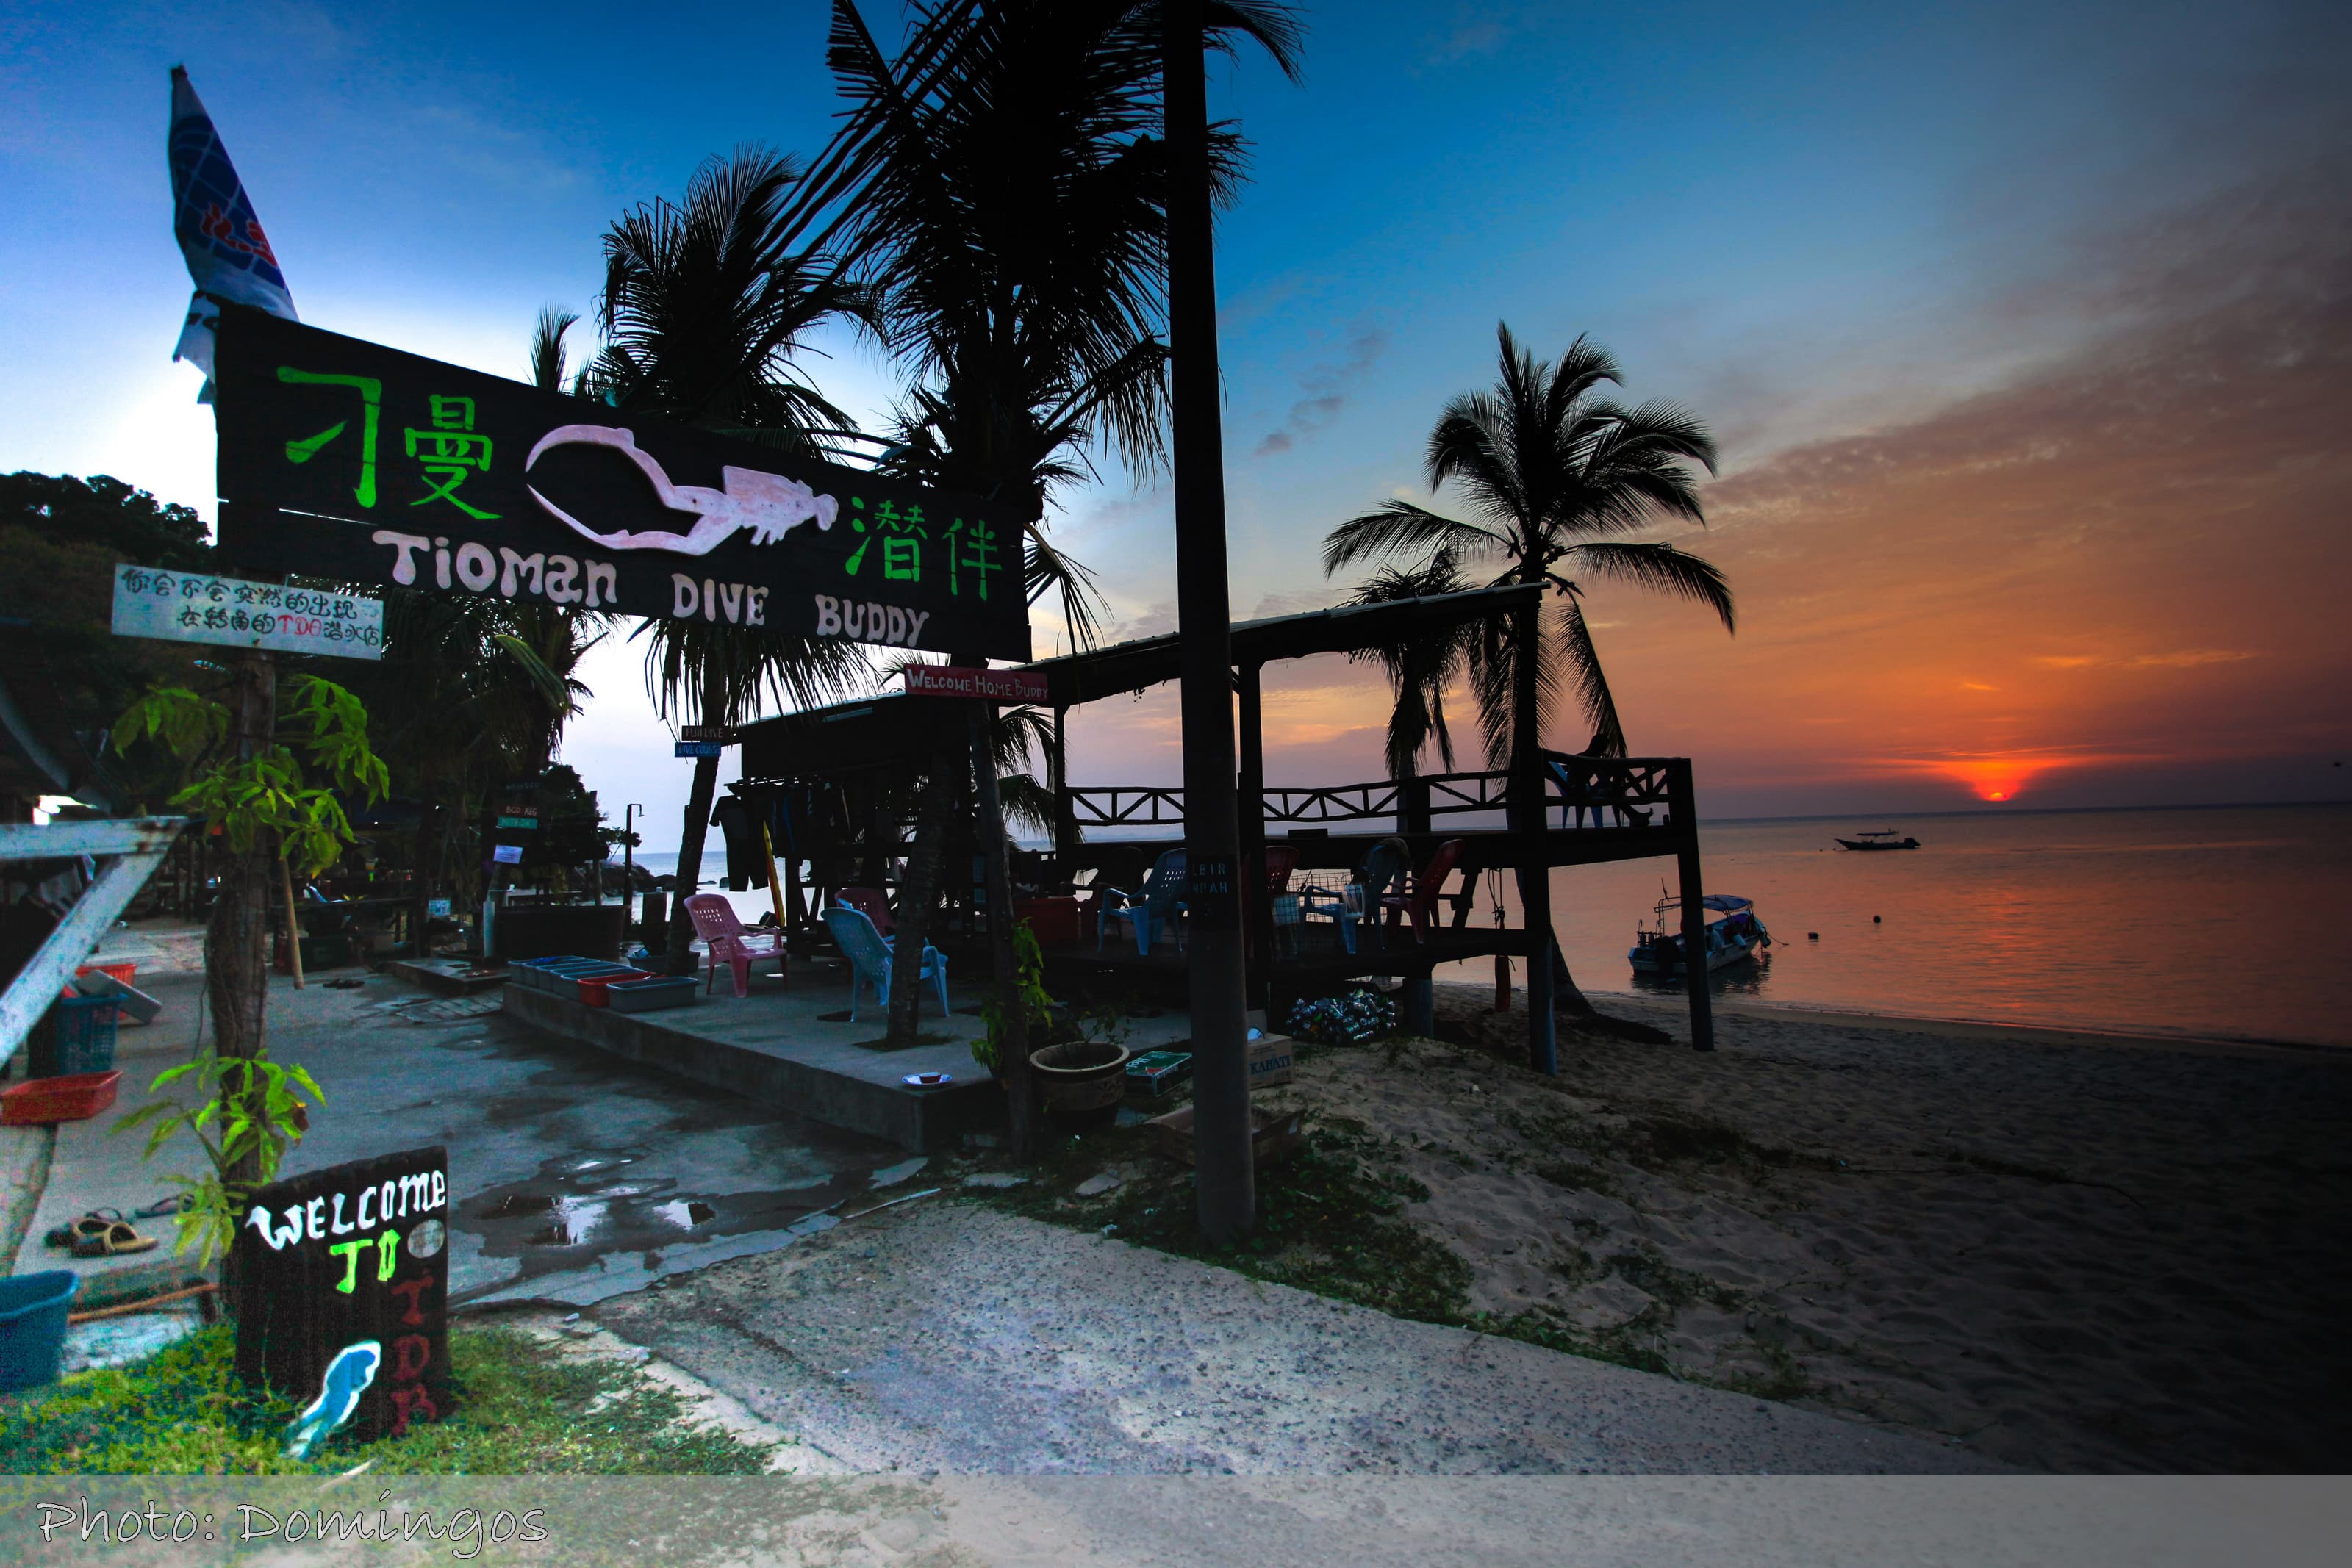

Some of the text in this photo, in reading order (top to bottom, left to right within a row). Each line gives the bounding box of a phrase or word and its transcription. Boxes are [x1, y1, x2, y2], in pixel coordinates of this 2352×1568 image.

[845, 496, 1002, 600] 潜伴
[671, 573, 769, 625] DIVE
[814, 594, 930, 647] BUDDY
[906, 669, 1049, 699] WELCOME HOME BUDDY
[329, 1228, 402, 1294] TO
